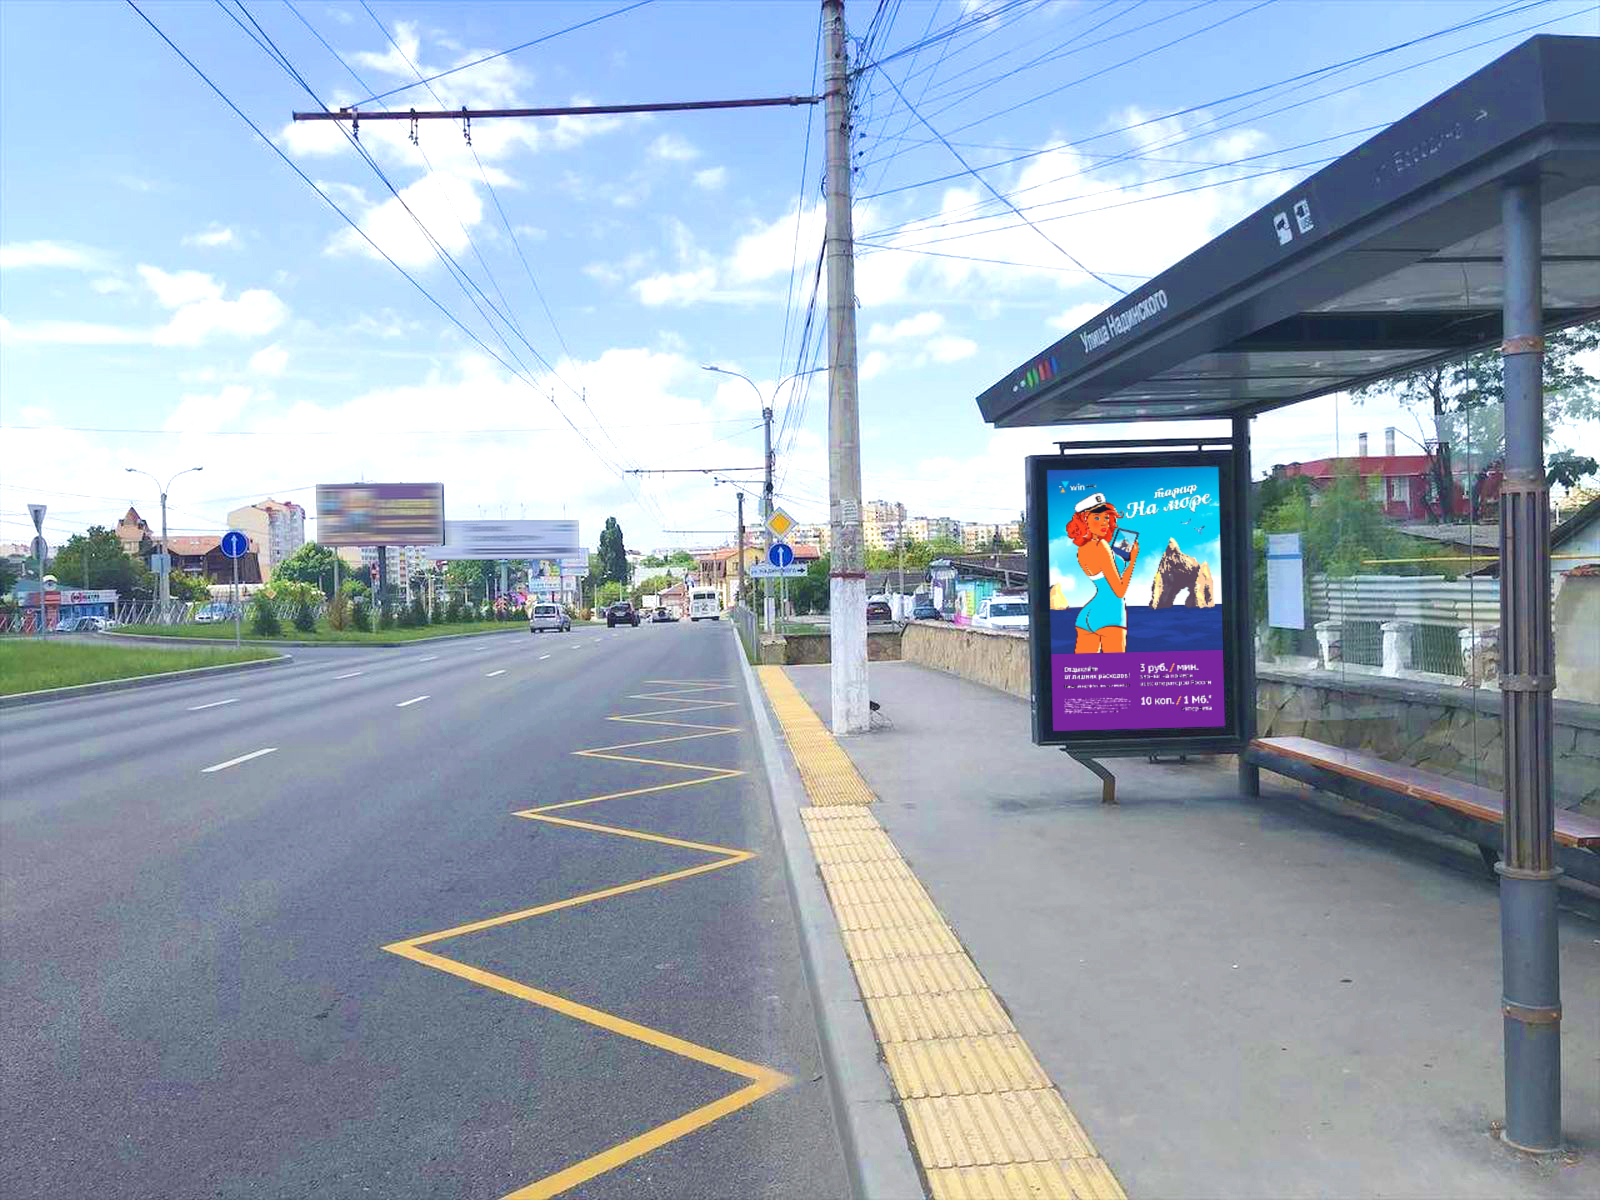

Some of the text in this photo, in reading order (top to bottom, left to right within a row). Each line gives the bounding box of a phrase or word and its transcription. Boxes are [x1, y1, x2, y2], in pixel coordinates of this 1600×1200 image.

[1080, 289, 1168, 353] Улица Надинского
[1154, 484, 1197, 499] тариф
[1126, 493, 1212, 519] На море
[1140, 663, 1146, 673] 3
[1141, 696, 1153, 706] 10
